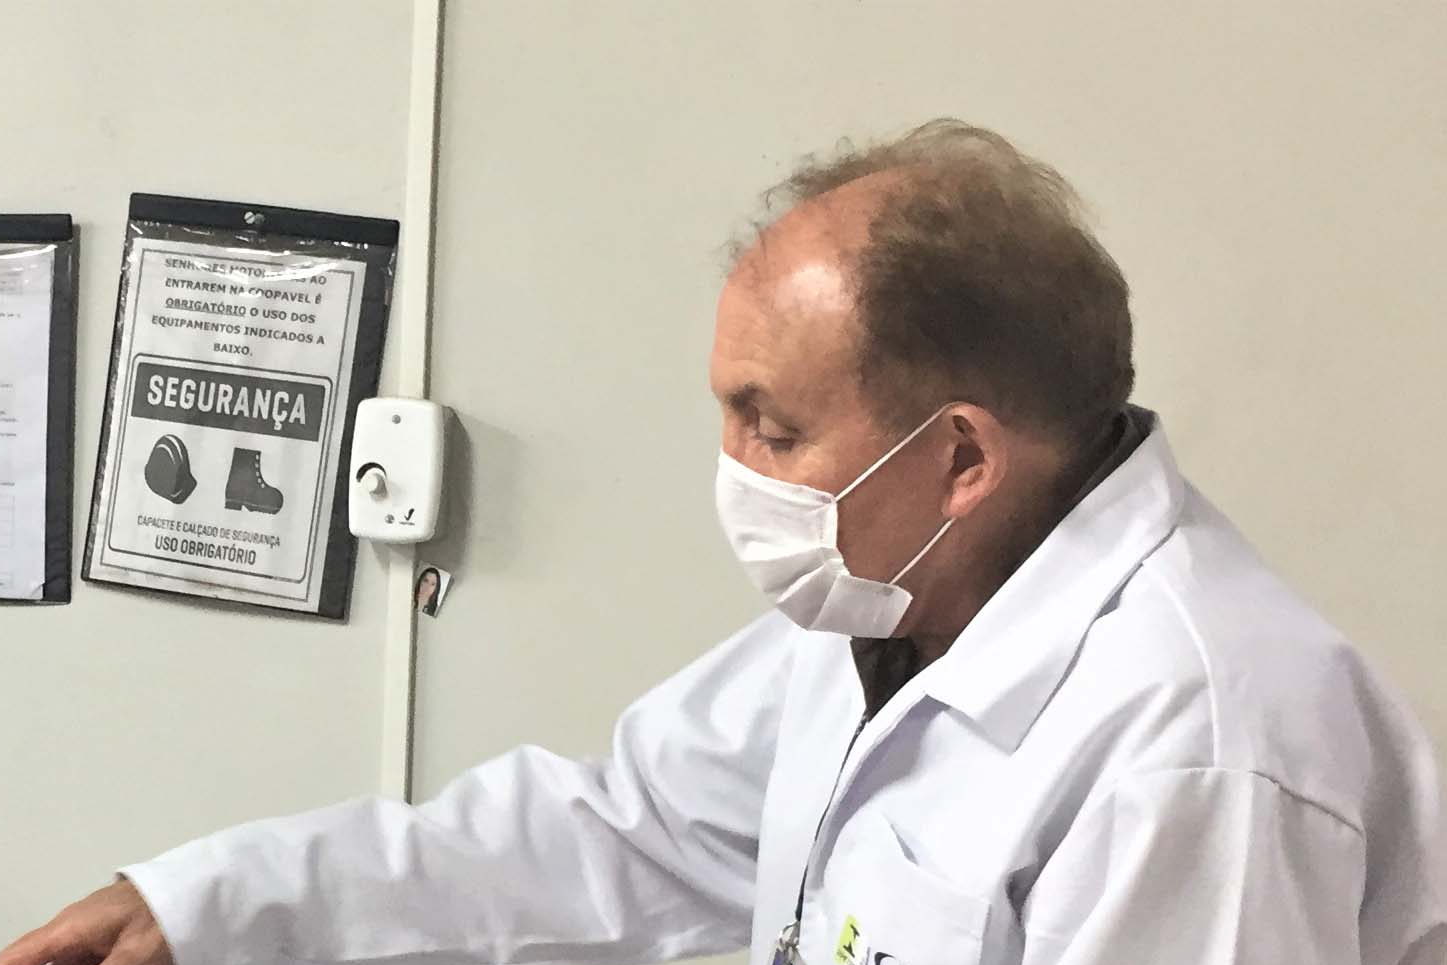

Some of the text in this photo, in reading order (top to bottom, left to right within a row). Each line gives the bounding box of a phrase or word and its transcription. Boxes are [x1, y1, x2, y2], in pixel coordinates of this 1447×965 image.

[165, 278, 226, 293] ENTRAREM
[229, 284, 245, 294] NA
[248, 287, 311, 304] COOPAVEL
[309, 275, 327, 285] AO
[165, 297, 316, 324] OBRIGATÓRIO O USO DOS
[152, 315, 325, 345] EQUIPAMENTOS INDICADOS A
[213, 343, 253, 356] BAIXO.
[147, 375, 306, 431] SEGURANÇA
[137, 515, 281, 549] CAPACETE E CALÇADO DE SEGURANÇA
[155, 535, 257, 566] USO OBRIGATÓRIO
